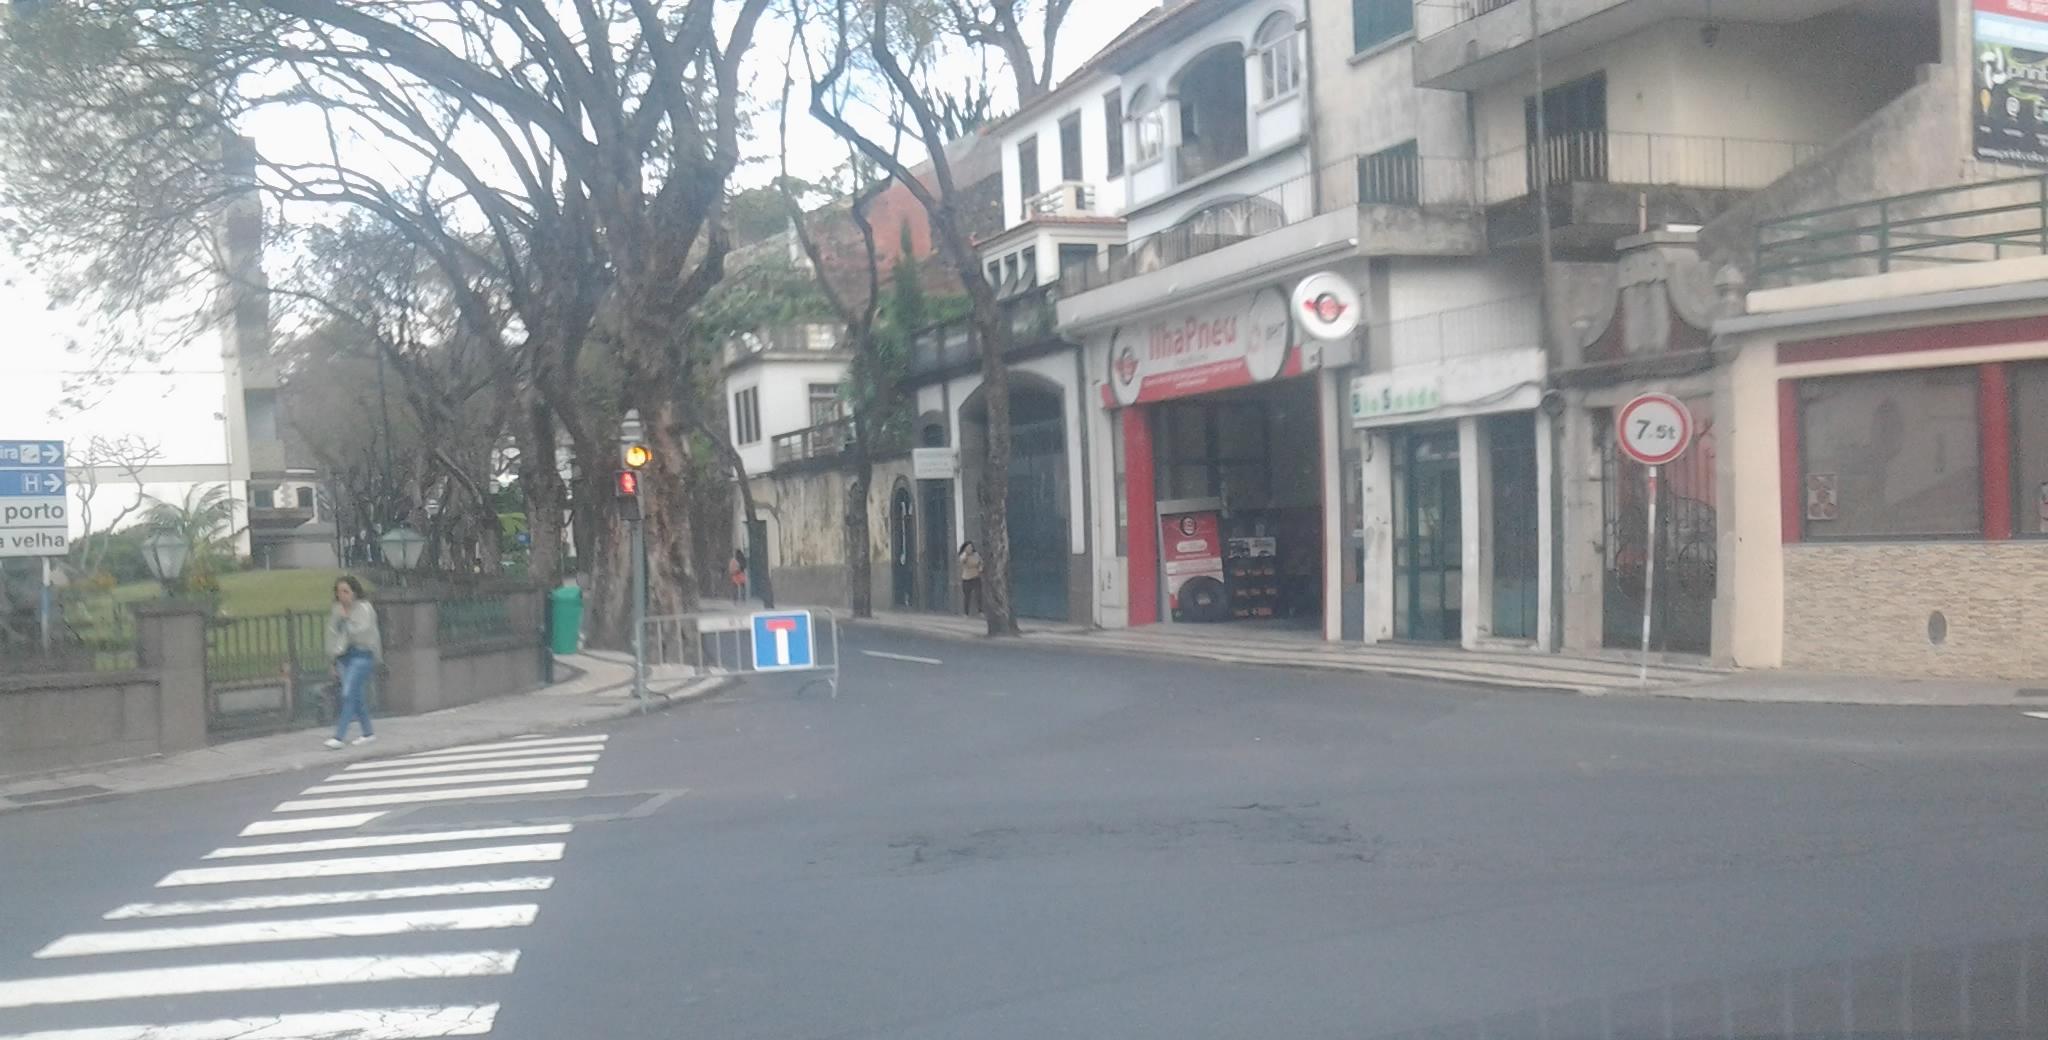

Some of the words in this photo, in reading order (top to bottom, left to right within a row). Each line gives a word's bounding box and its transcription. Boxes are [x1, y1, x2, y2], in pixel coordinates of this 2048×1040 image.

[1148, 314, 1238, 360] IlhaPneu
[5, 503, 65, 524] porto
[12, 533, 65, 548] velha
